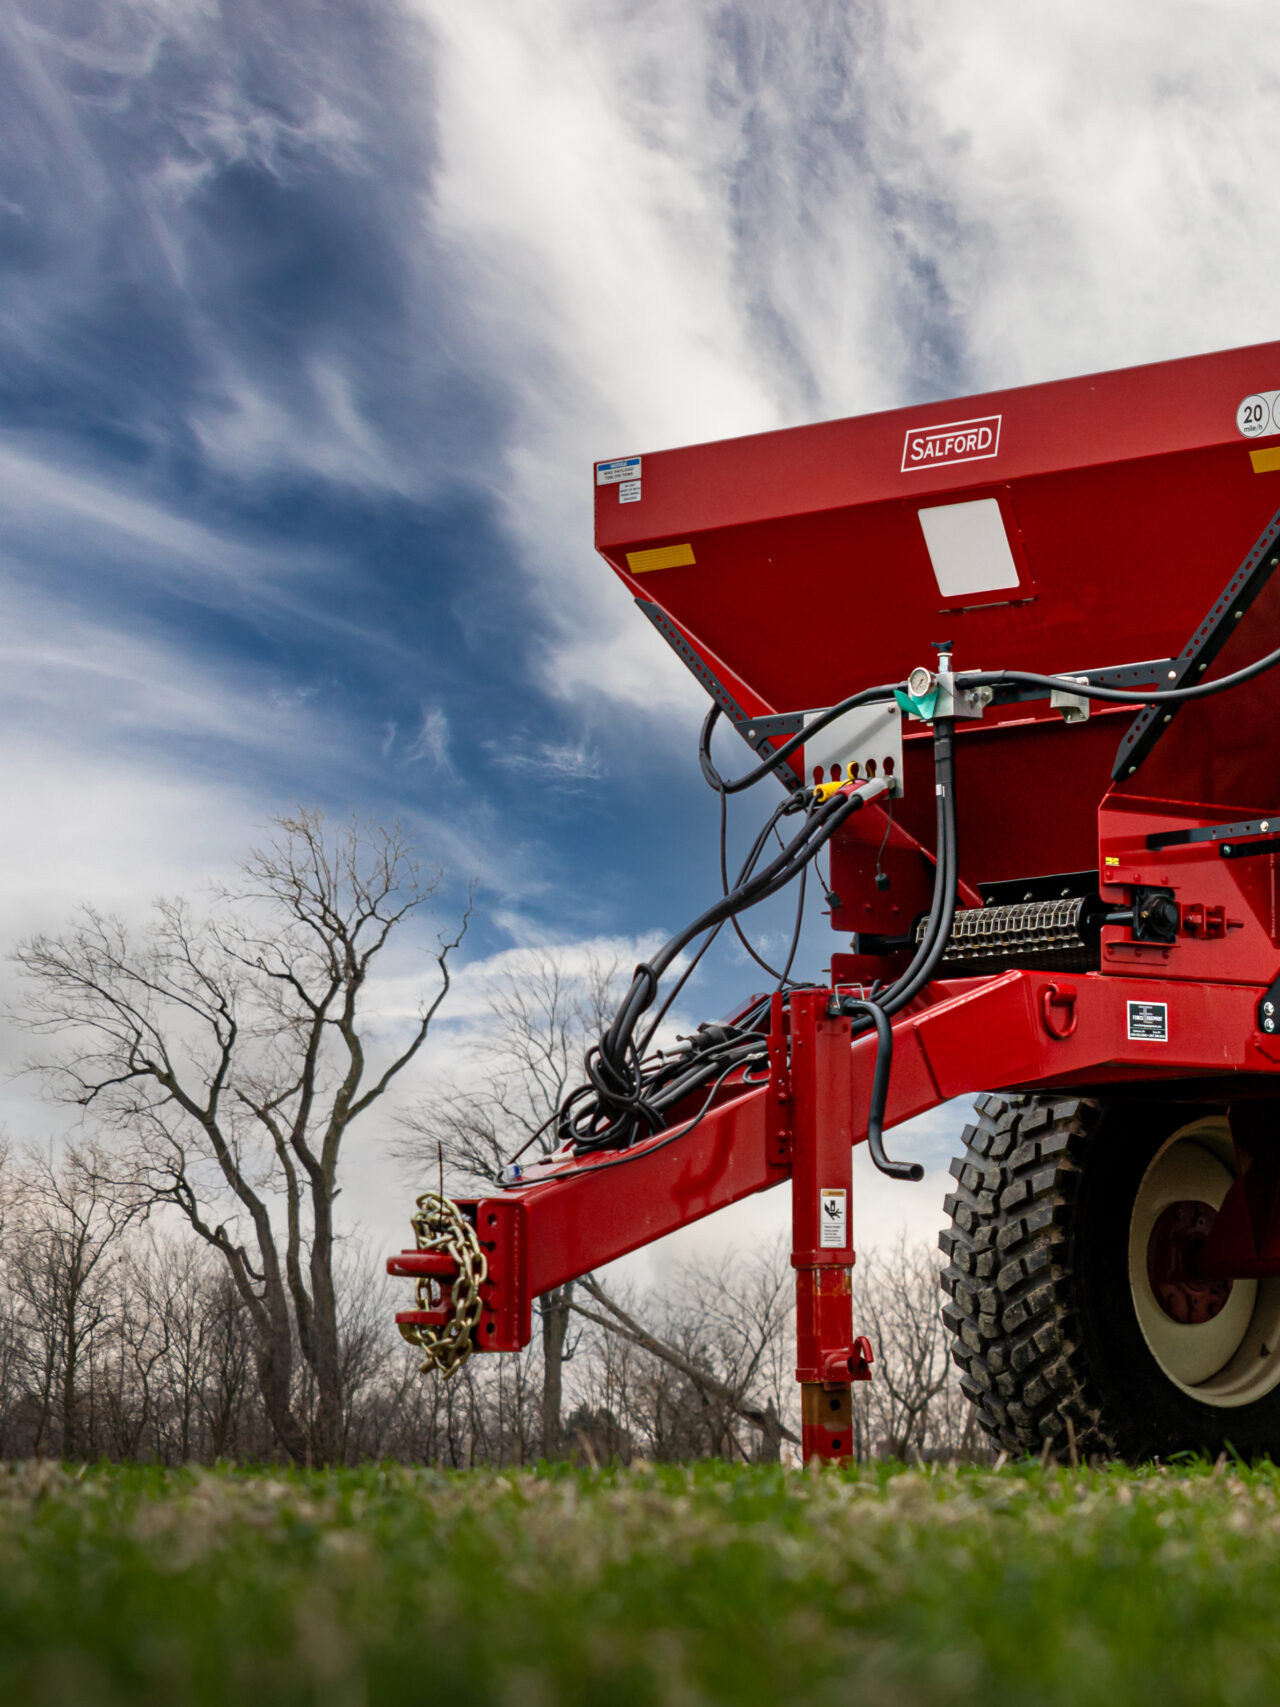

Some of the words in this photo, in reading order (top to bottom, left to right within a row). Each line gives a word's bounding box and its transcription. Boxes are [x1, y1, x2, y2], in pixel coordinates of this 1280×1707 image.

[1243, 404, 1263, 424] 20
[1243, 424, 1263, 433] mile/h
[910, 427, 992, 460] SALFORD
